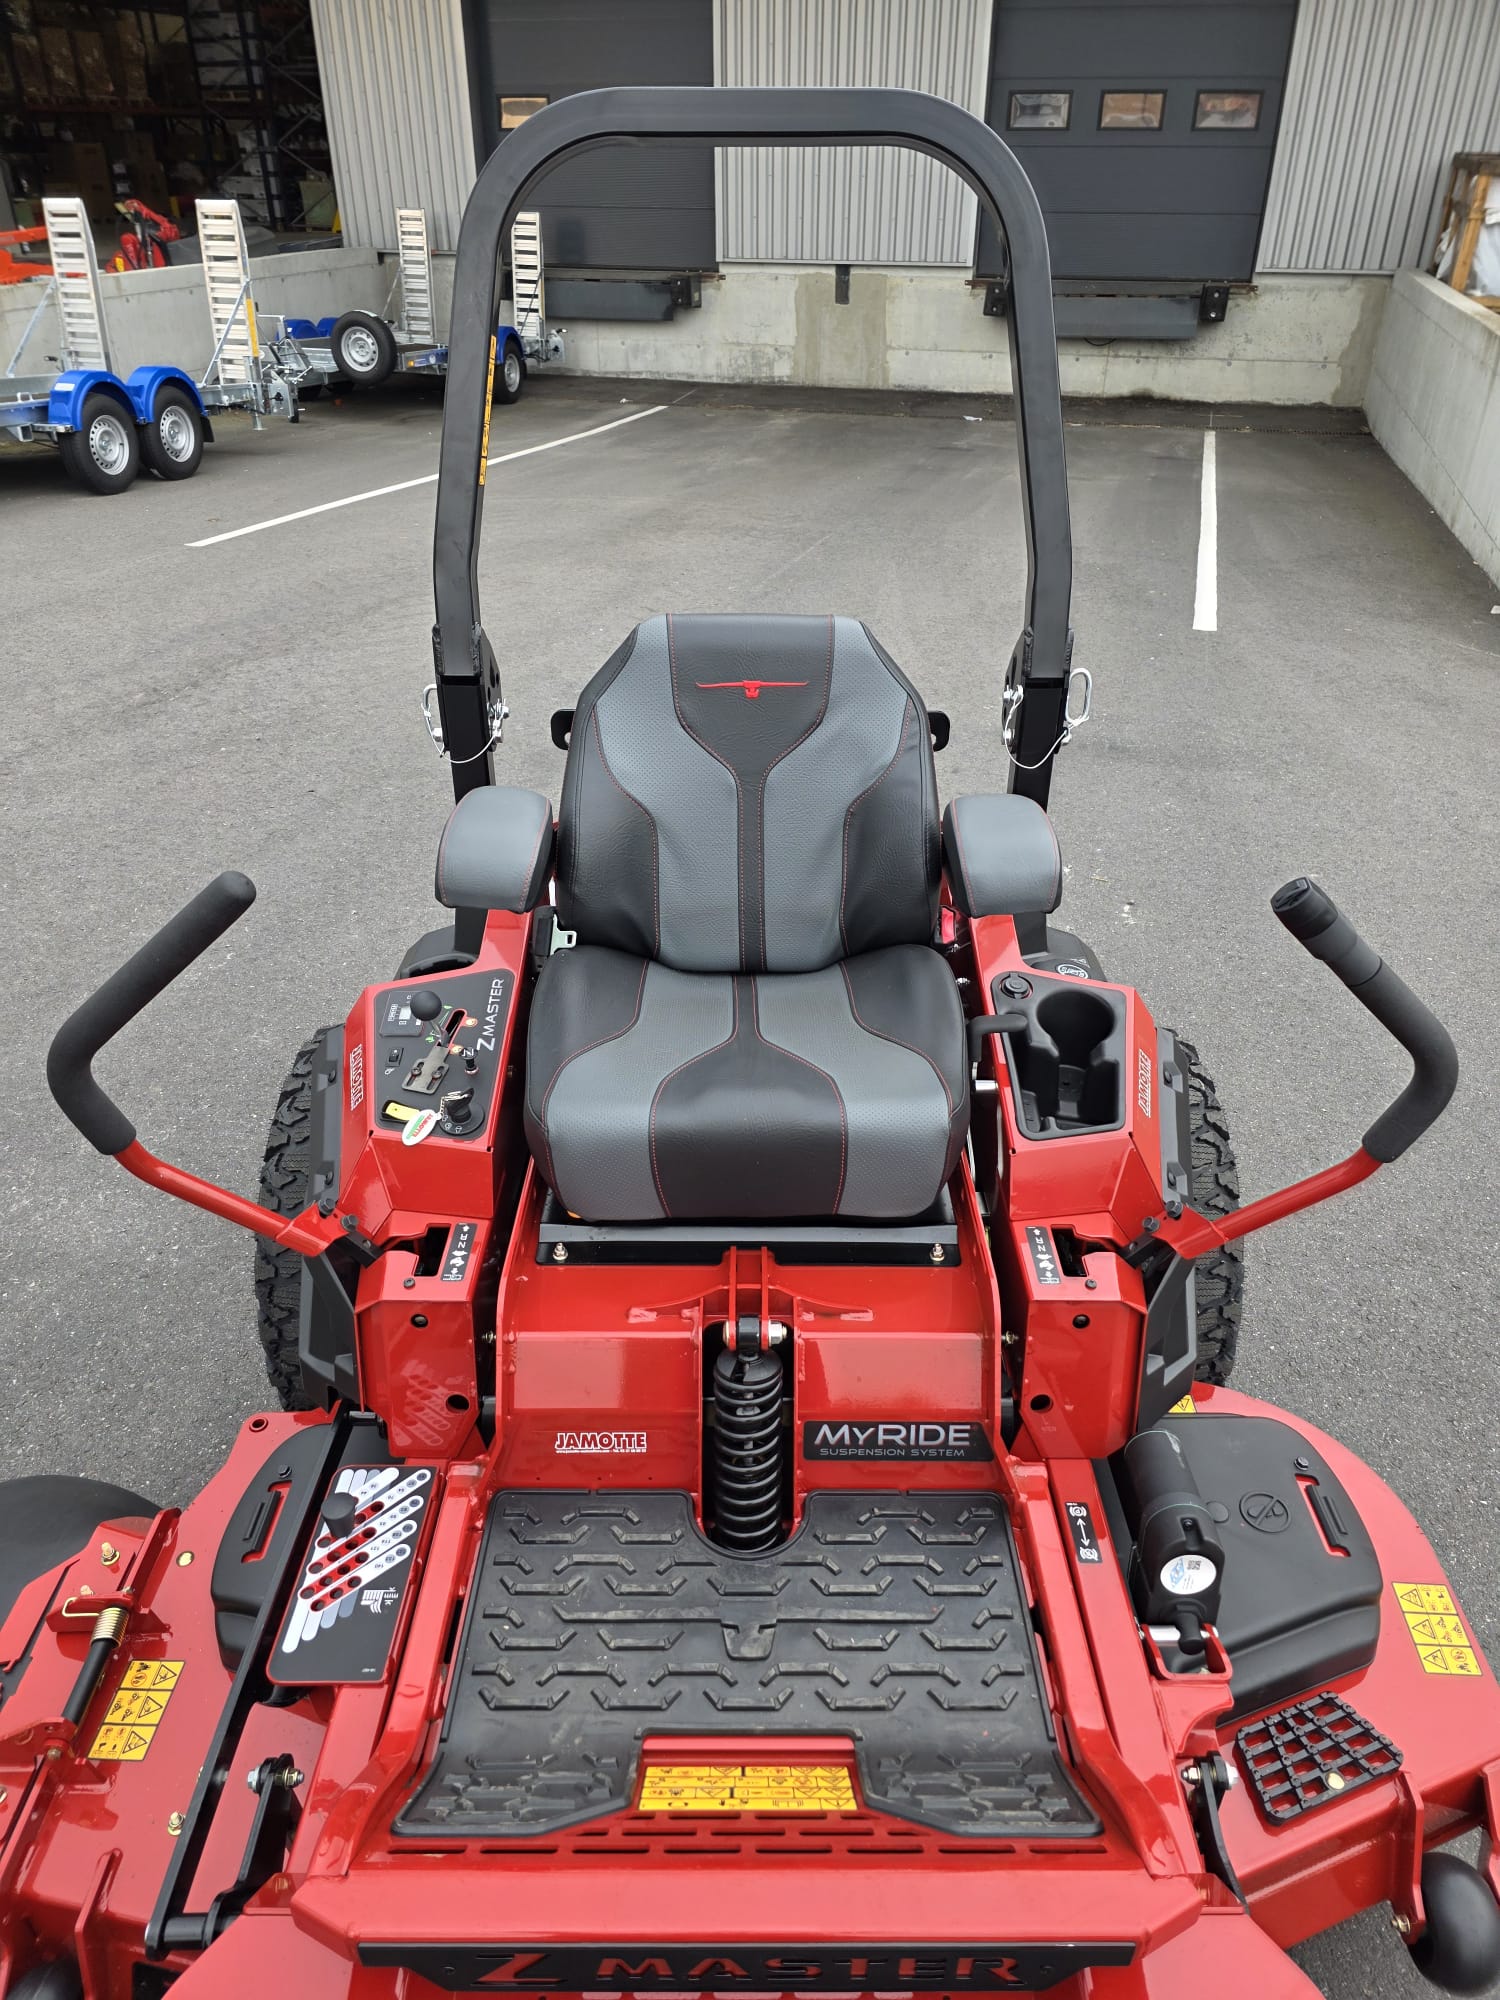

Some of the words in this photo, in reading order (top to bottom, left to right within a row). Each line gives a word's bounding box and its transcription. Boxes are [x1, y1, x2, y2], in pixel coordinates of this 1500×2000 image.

[351, 1043, 364, 1109] JAMOTTE
[1138, 1048, 1150, 1117] JAMOTTE
[554, 1431, 647, 1450] JAMOTTE
[820, 1448, 905, 1457] SUSPENSION
[911, 1448, 965, 1457] SYSTEM
[471, 1952, 567, 1987] Z
[596, 1956, 1026, 1986] MASTER
